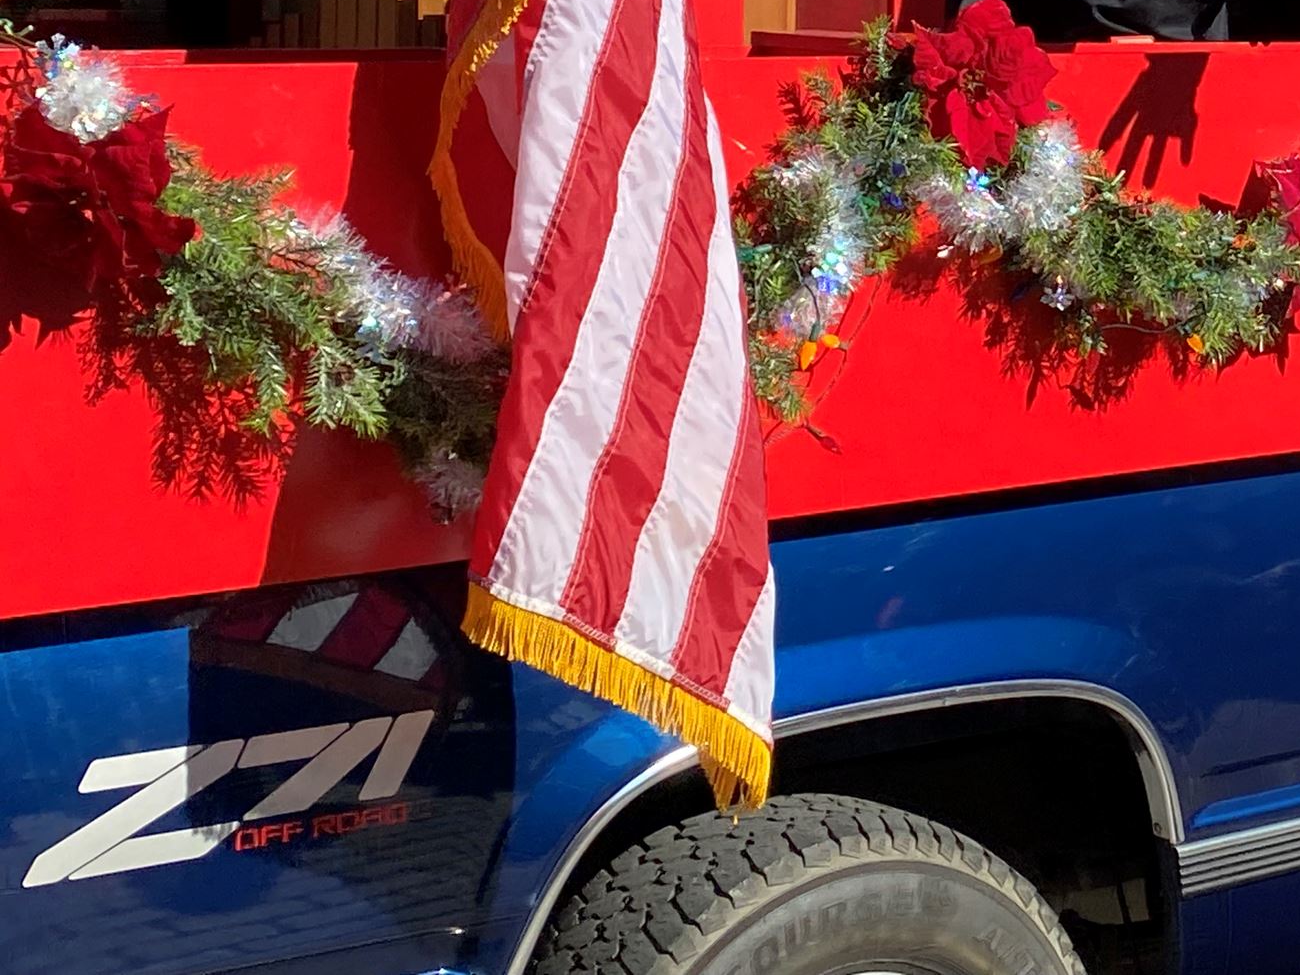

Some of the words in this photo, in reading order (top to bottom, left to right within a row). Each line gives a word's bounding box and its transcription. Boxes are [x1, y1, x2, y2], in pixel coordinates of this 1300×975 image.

[21, 709, 435, 889] Z71
[233, 819, 304, 852] OFF
[312, 801, 409, 840] ROAD
